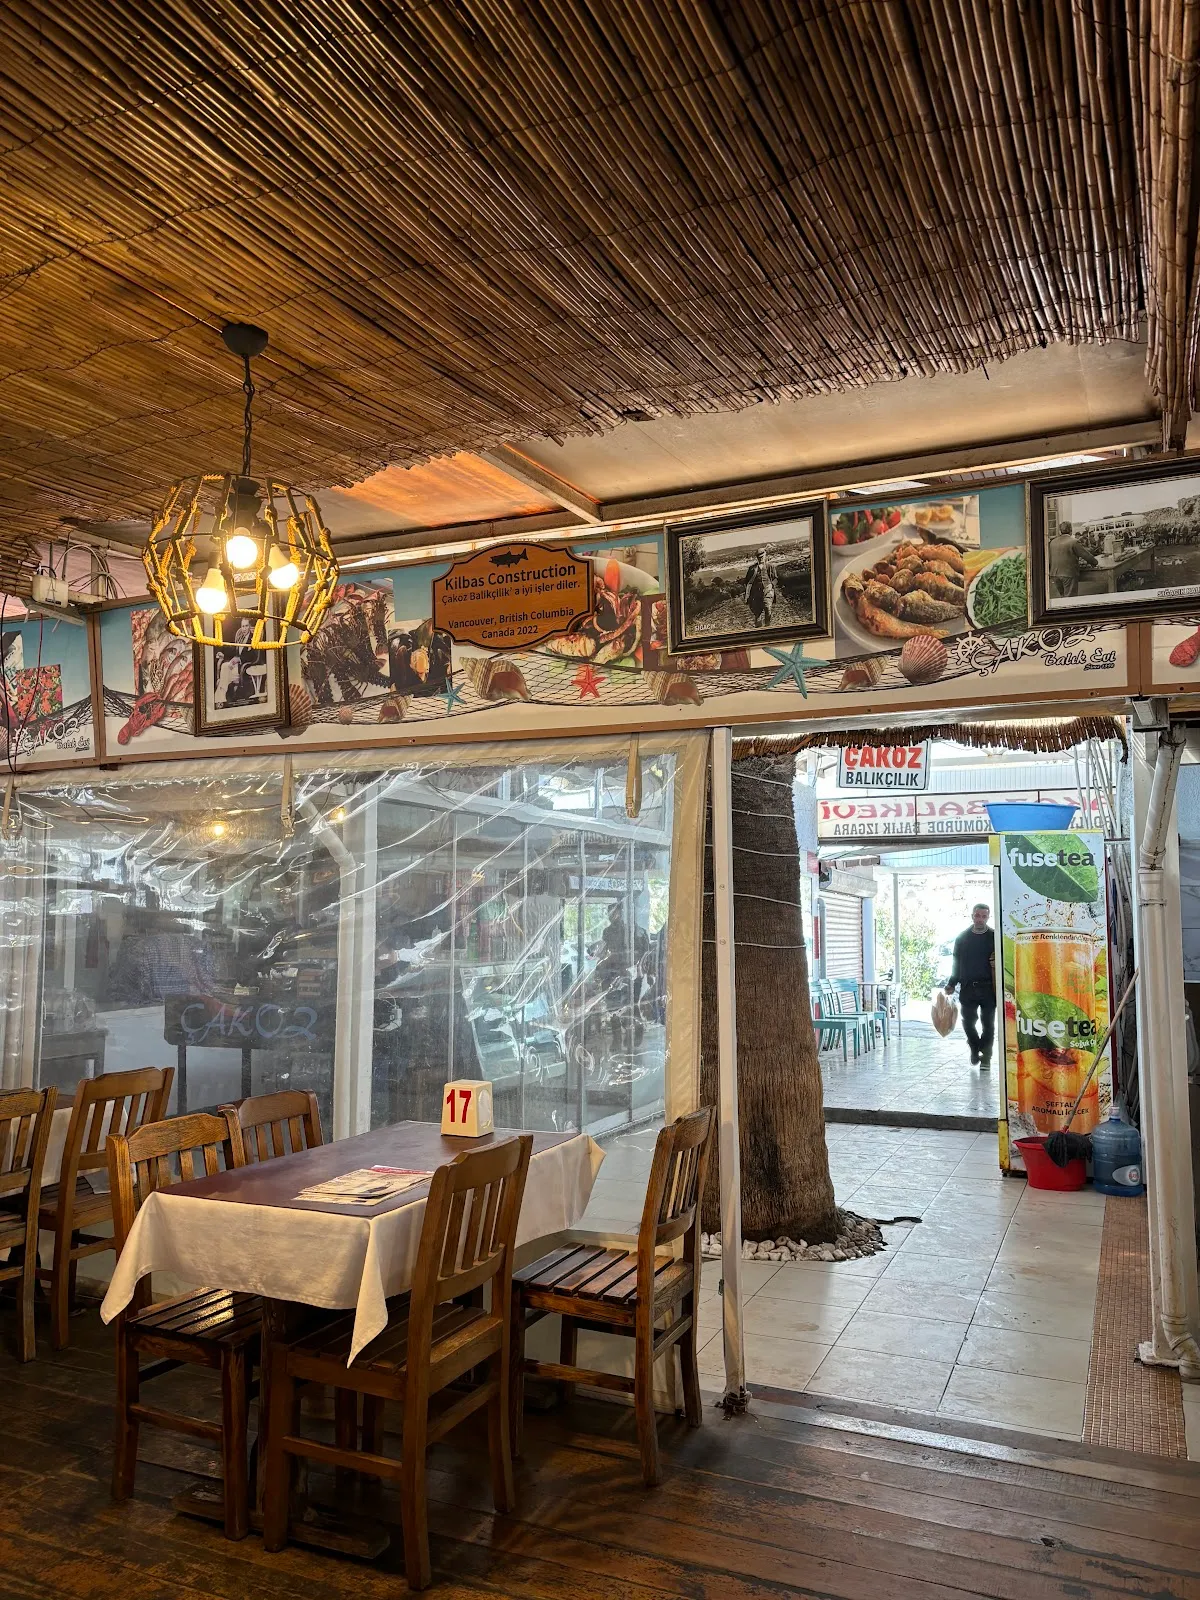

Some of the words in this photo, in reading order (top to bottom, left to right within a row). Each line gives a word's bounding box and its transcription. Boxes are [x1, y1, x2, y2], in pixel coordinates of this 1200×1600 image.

[445, 575, 485, 591] Kilbas
[488, 563, 576, 585] Construction
[441, 593, 468, 606] Çakoz
[514, 588, 520, 596] a
[522, 584, 533, 597] iyi
[534, 582, 554, 595] işler
[556, 579, 581, 591] diler.
[448, 617, 497, 629] Vancouver,
[499, 612, 528, 624] British
[530, 606, 574, 620] Columbia
[481, 627, 515, 639] Canada
[516, 624, 539, 636] 2022
[844, 746, 922, 770] ÇAKOZ
[846, 771, 919, 787] BALIKÇILIK
[446, 1089, 472, 1123] 17
[1031, 1105, 1064, 1116] AROMALI
